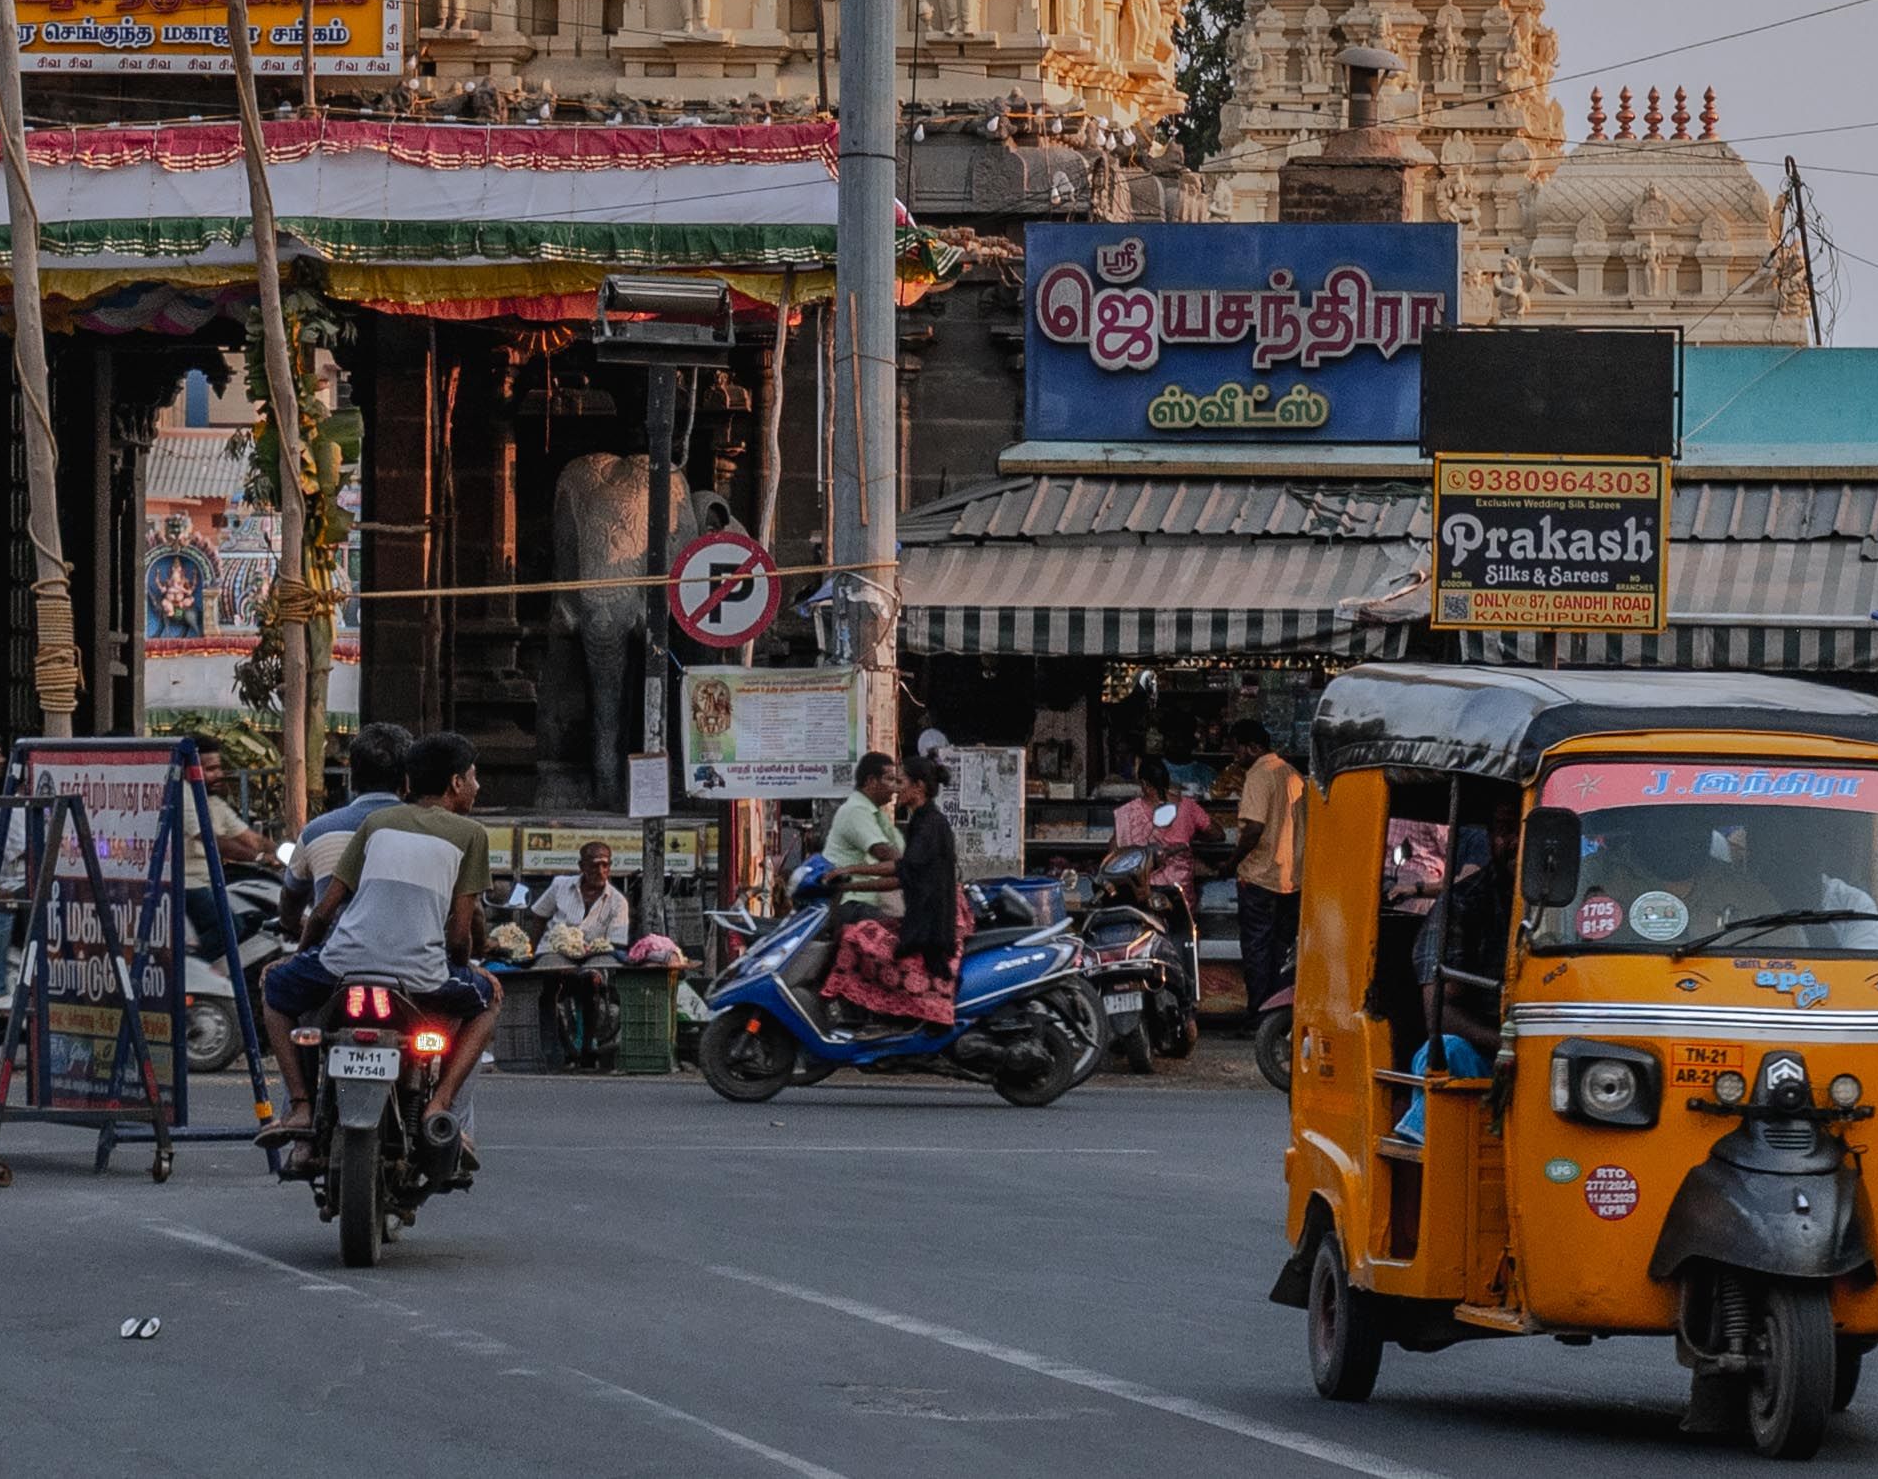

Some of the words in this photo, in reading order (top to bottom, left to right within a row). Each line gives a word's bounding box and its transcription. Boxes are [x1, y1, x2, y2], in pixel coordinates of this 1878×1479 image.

[44, 18, 152, 45] செங்குந்த
[37, 56, 60, 68] சிவ
[69, 56, 92, 68] சிவ
[118, 58, 141, 70] சிவ
[147, 58, 171, 70] சிவ
[188, 58, 211, 70] சிவ
[261, 59, 284, 71] சிவ
[335, 59, 358, 71] சிவ
[366, 59, 389, 71] சிவ
[1152, 383, 1325, 424] ஸ்வீட்ஸ்
[1468, 469, 1652, 494] 9380964303
[1475, 498, 1522, 509] Exclusive
[1523, 499, 1565, 510] Wedding
[1567, 499, 1586, 510] Silk
[1588, 500, 1621, 510] Sarees
[1442, 513, 1654, 567] Prakash
[1485, 564, 1530, 585] Silks
[1533, 568, 1546, 586] &
[1549, 565, 1609, 586] Sarees
[709, 562, 754, 624] P
[1552, 595, 1608, 610] GANDHI
[1612, 596, 1651, 611] ROAD
[1474, 611, 1651, 624] KANCHIPURAM-1
[1581, 902, 1614, 917] 1705
[348, 1051, 381, 1063] TN-11
[1685, 1048, 1728, 1064] TN-21
[343, 1065, 386, 1077] W-7548
[1596, 1168, 1627, 1179] RTO
[1597, 1205, 1627, 1216] KPM
